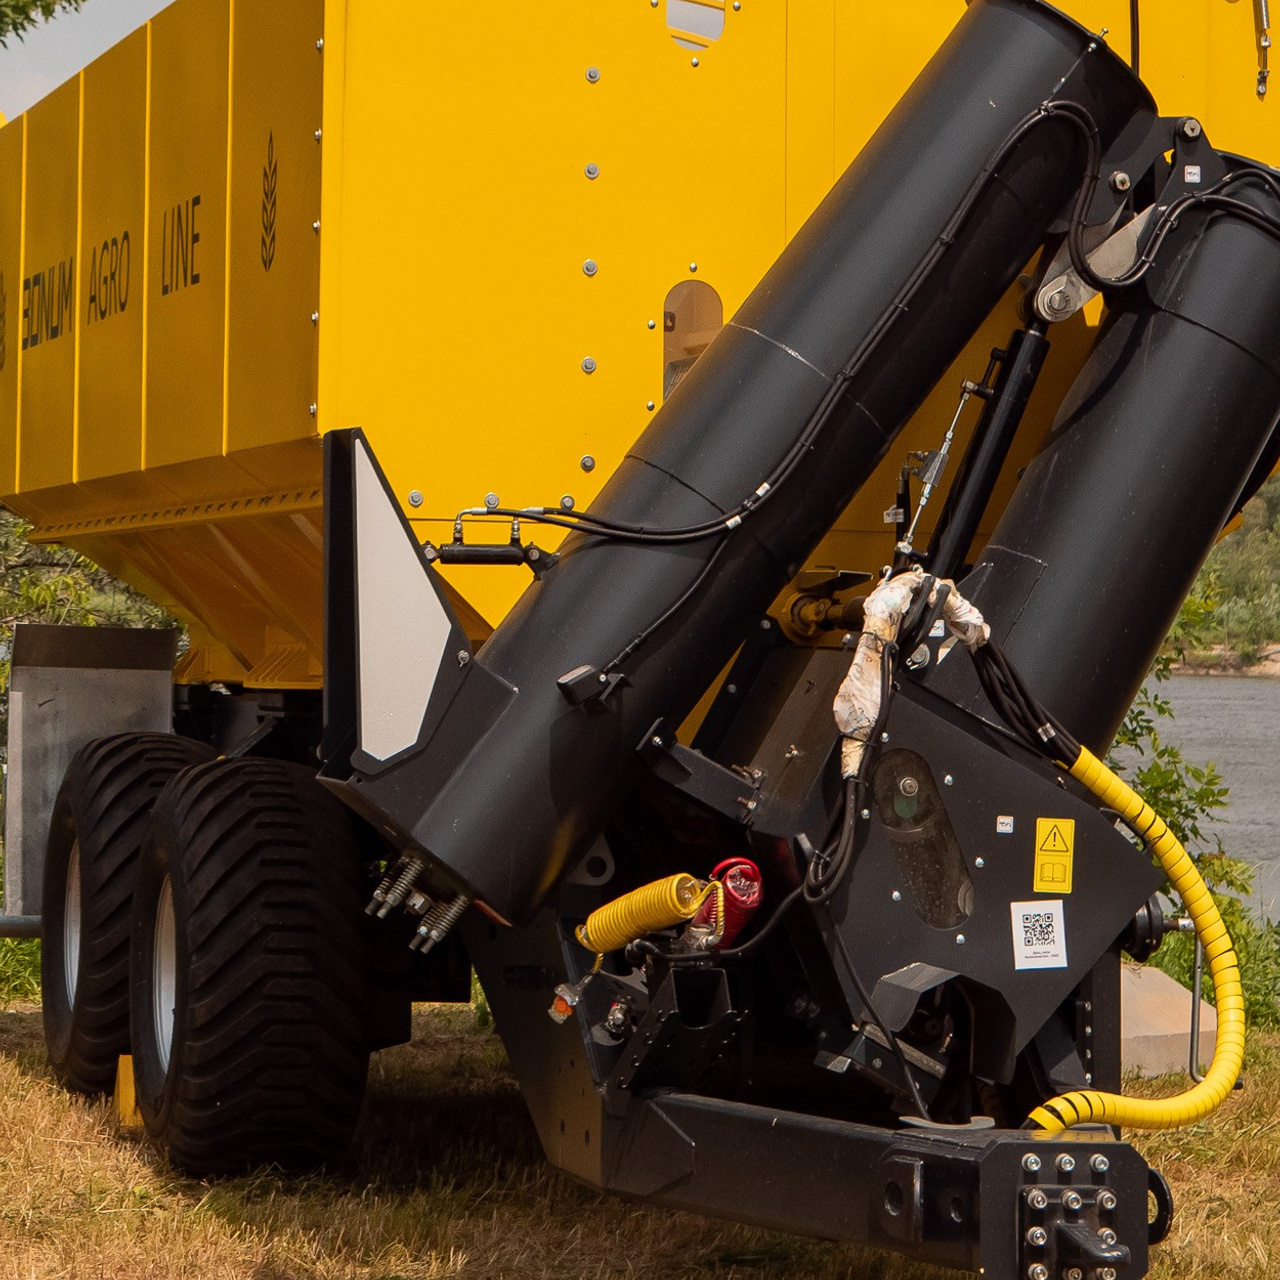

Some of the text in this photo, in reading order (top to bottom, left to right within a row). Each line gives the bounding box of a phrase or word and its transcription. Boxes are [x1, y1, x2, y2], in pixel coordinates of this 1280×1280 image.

[22, 194, 202, 351] BONUM AGRO LINE
